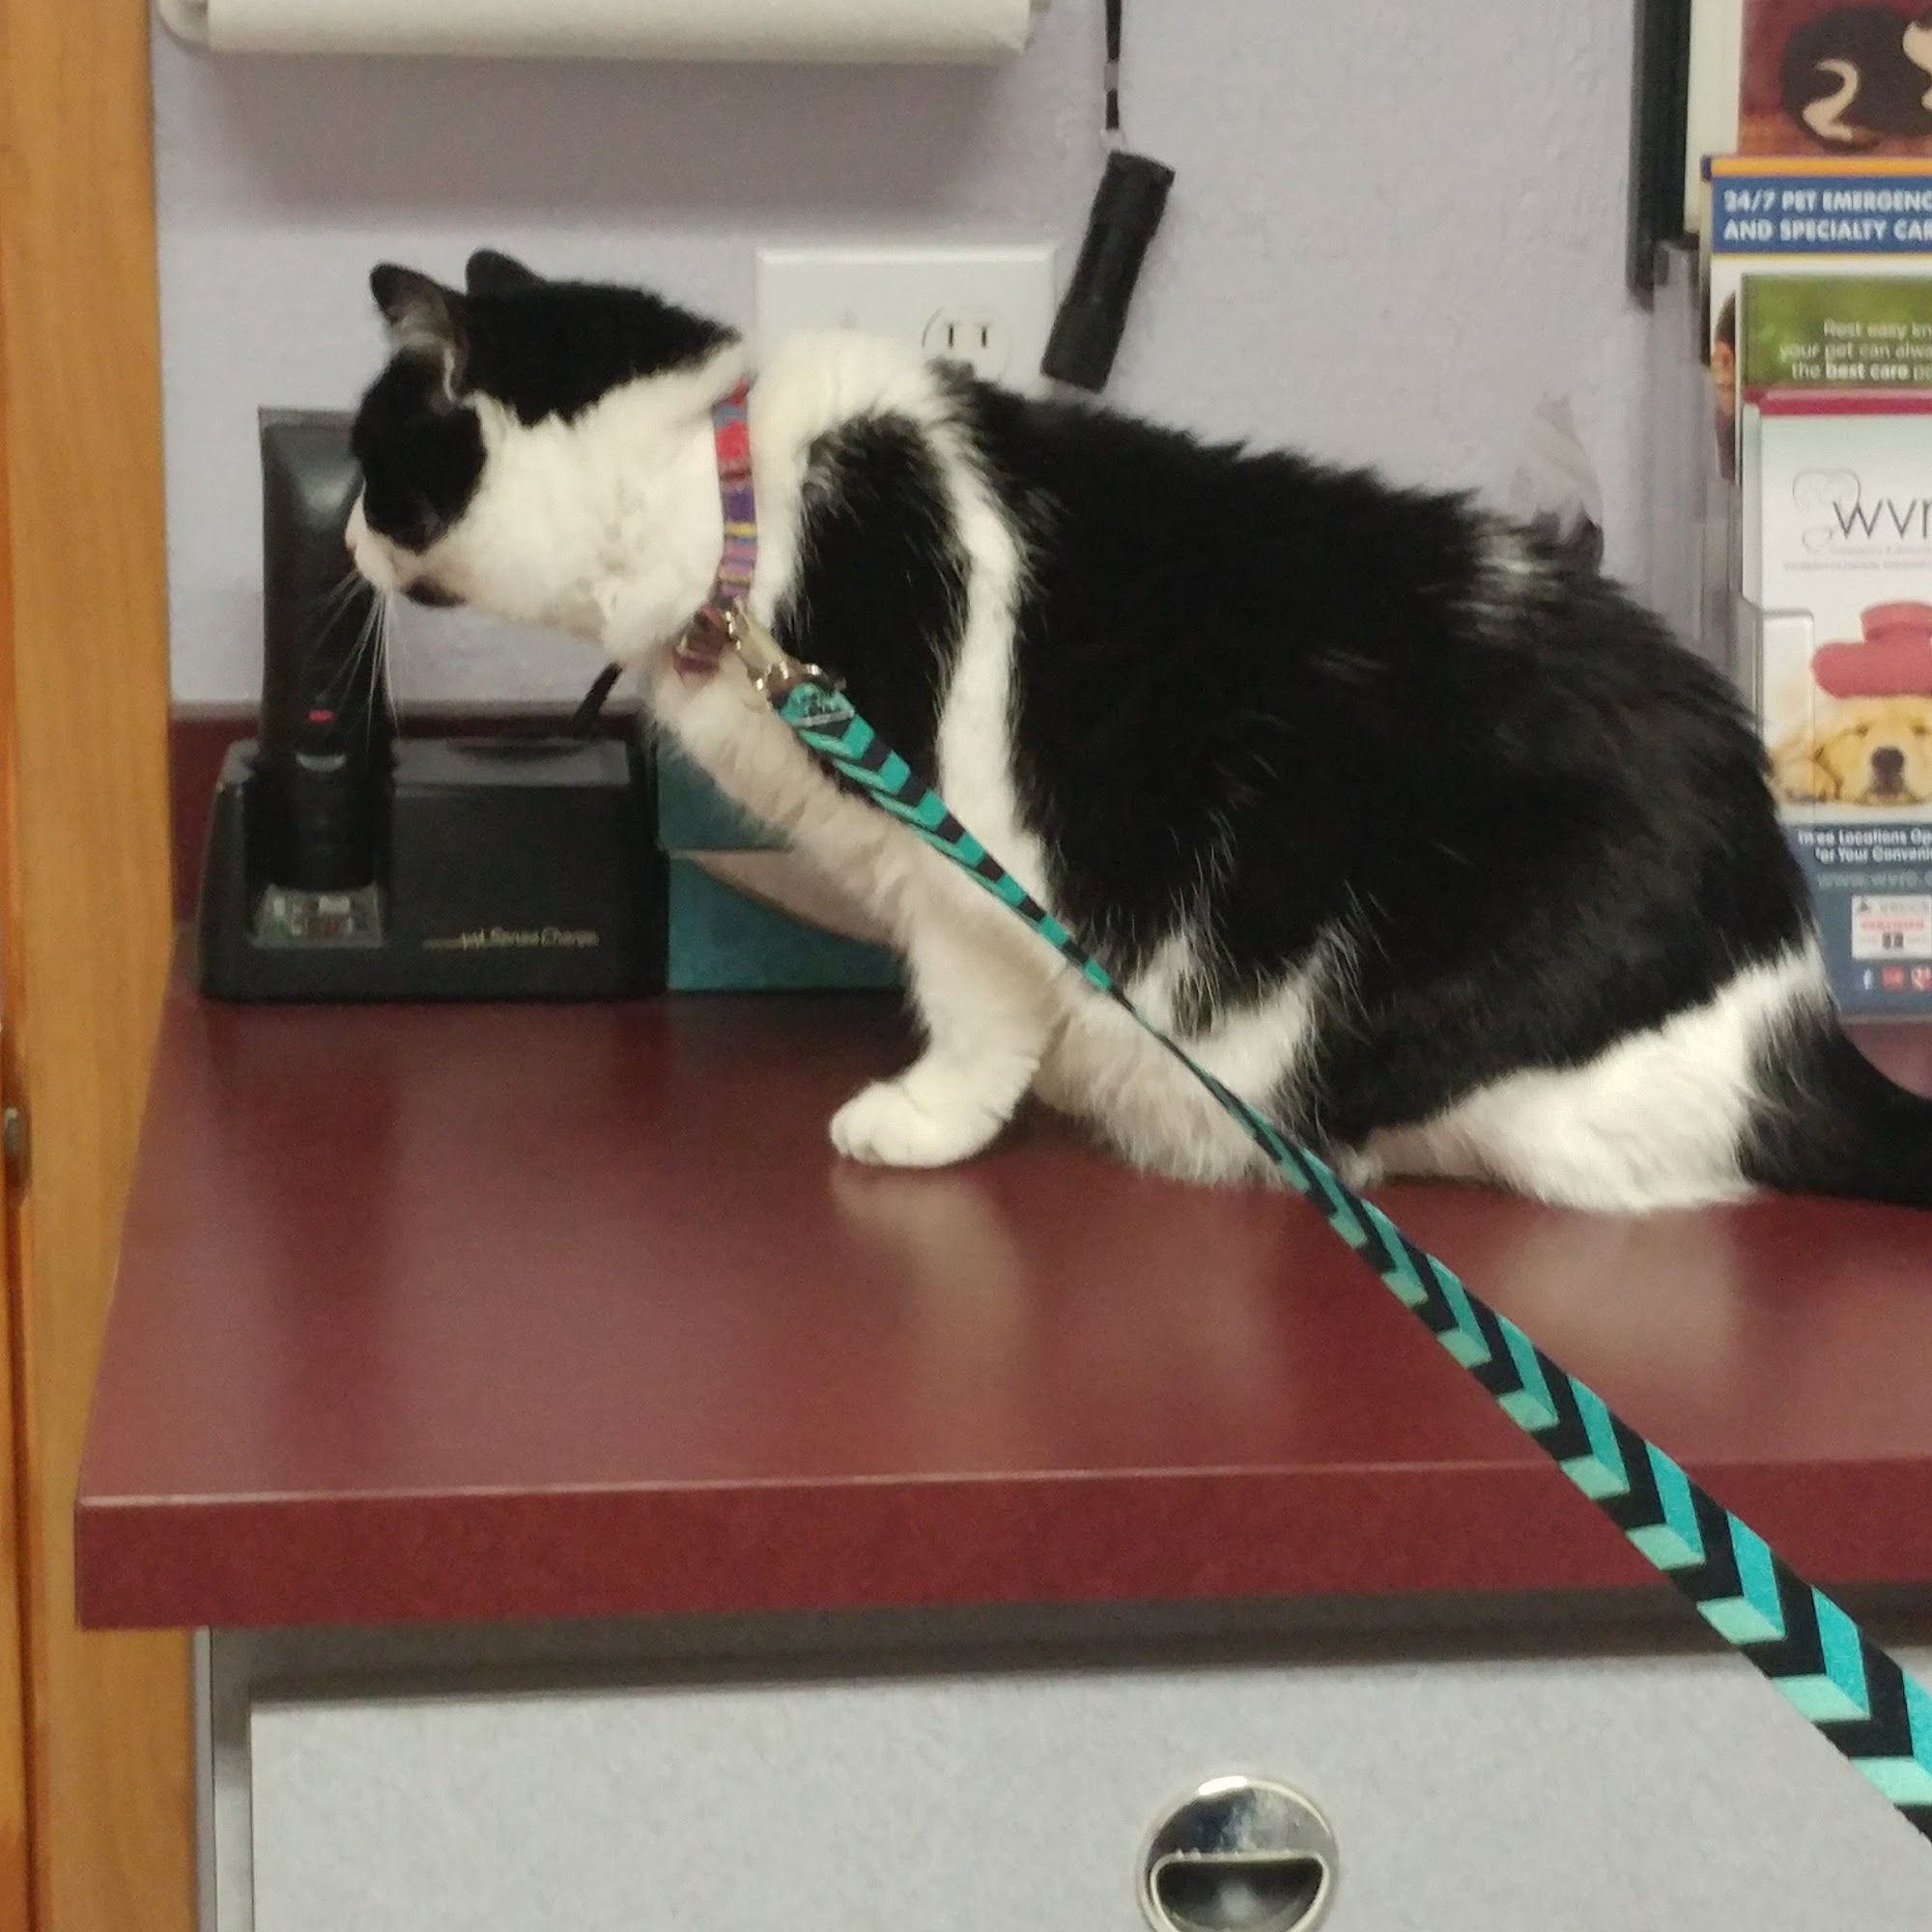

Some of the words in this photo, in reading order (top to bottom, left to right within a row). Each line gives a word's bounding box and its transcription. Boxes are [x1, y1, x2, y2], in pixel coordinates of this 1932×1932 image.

[1723, 189, 1776, 213] 24/7
[1782, 189, 1816, 213] PET
[1723, 218, 1774, 242] AND
[1779, 218, 1888, 242] SPECIALTY
[1792, 361, 1821, 380] the
[1826, 361, 1864, 380] best
[1870, 363, 1909, 380] care
[1838, 829, 1906, 846] Locations
[1837, 846, 1868, 863] Your
